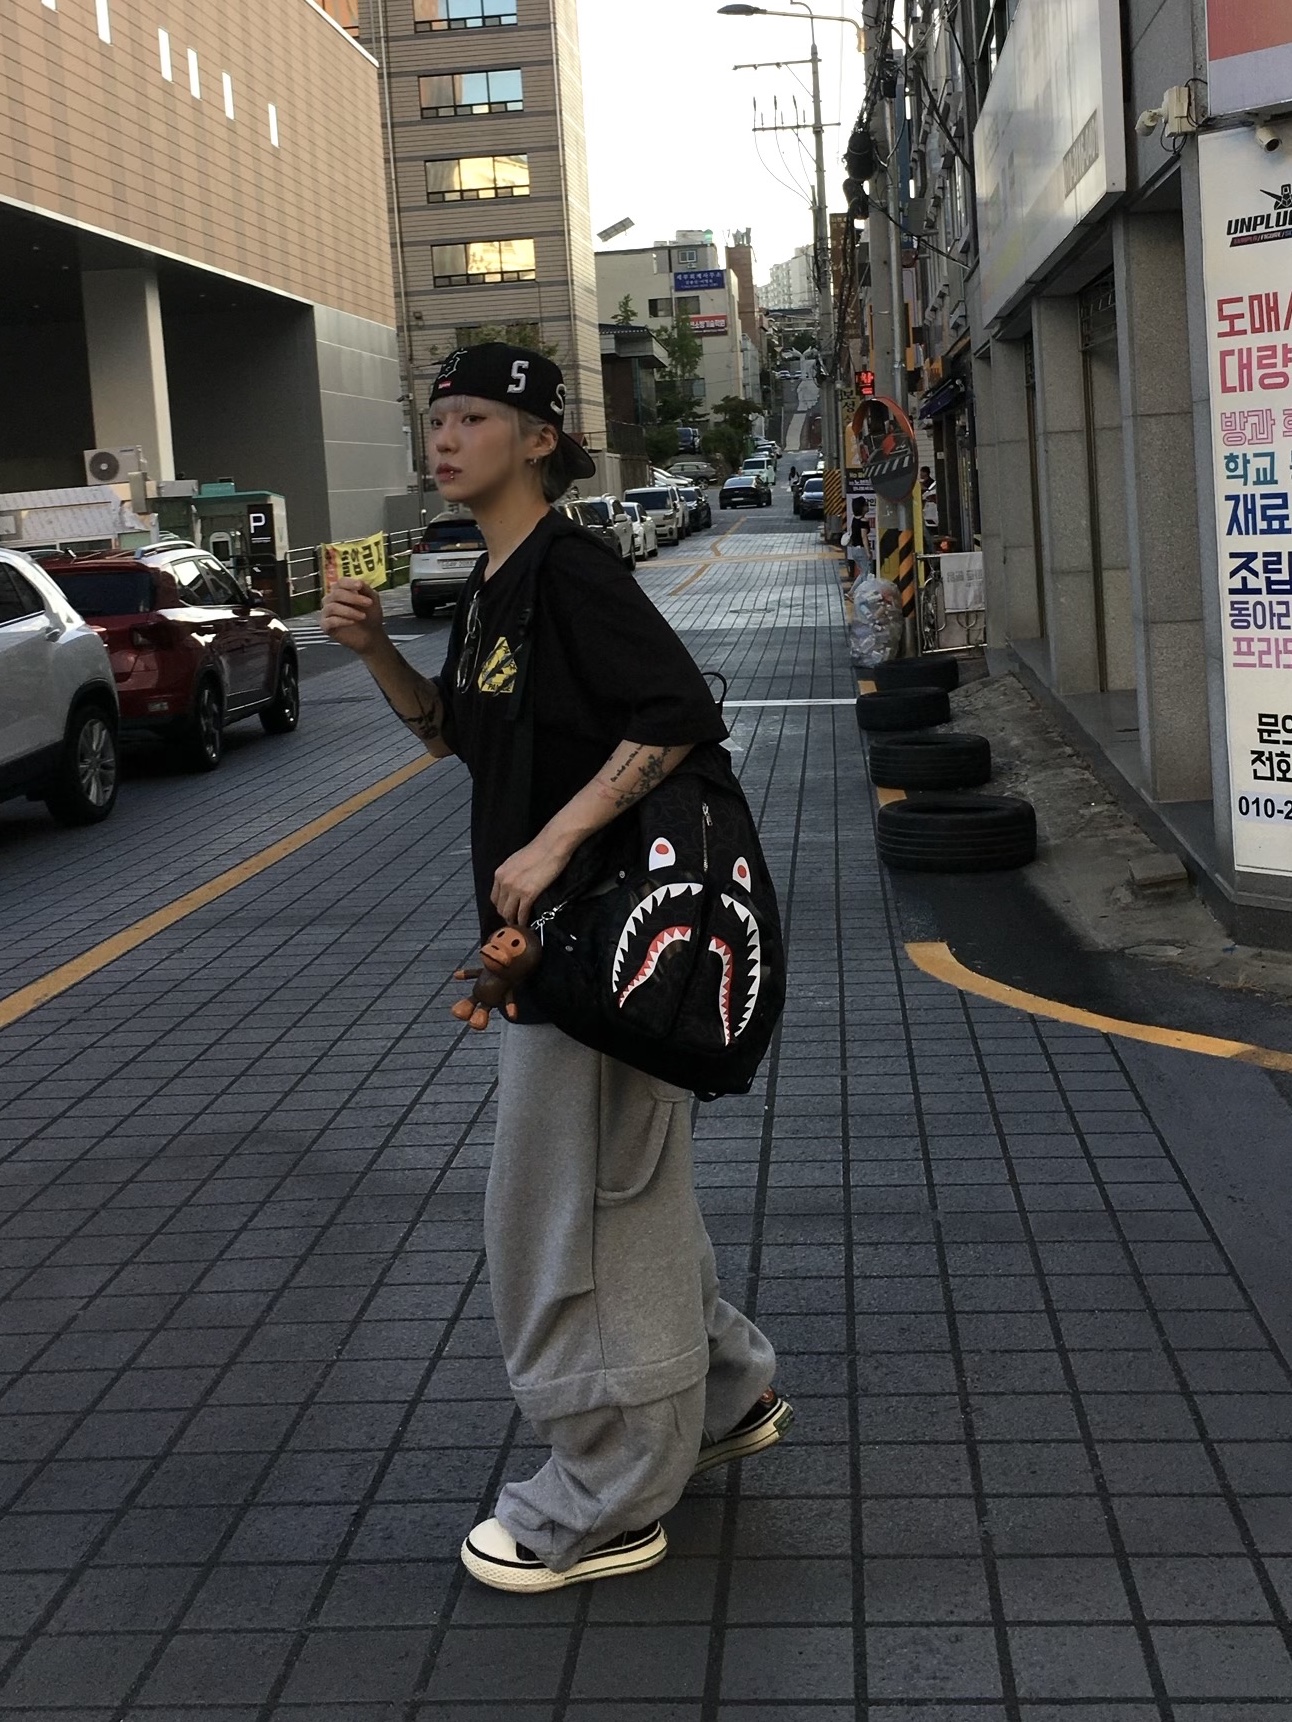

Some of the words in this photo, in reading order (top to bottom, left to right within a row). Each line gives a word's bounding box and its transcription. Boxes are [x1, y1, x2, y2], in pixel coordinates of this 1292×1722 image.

[1226, 209, 1292, 236] UNPLU
[1217, 290, 1292, 339] 도매
[506, 360, 530, 394] S
[1221, 408, 1276, 447] 방과
[1224, 451, 1279, 487] 학교
[249, 513, 266, 534] P
[1224, 492, 1292, 536] 재료
